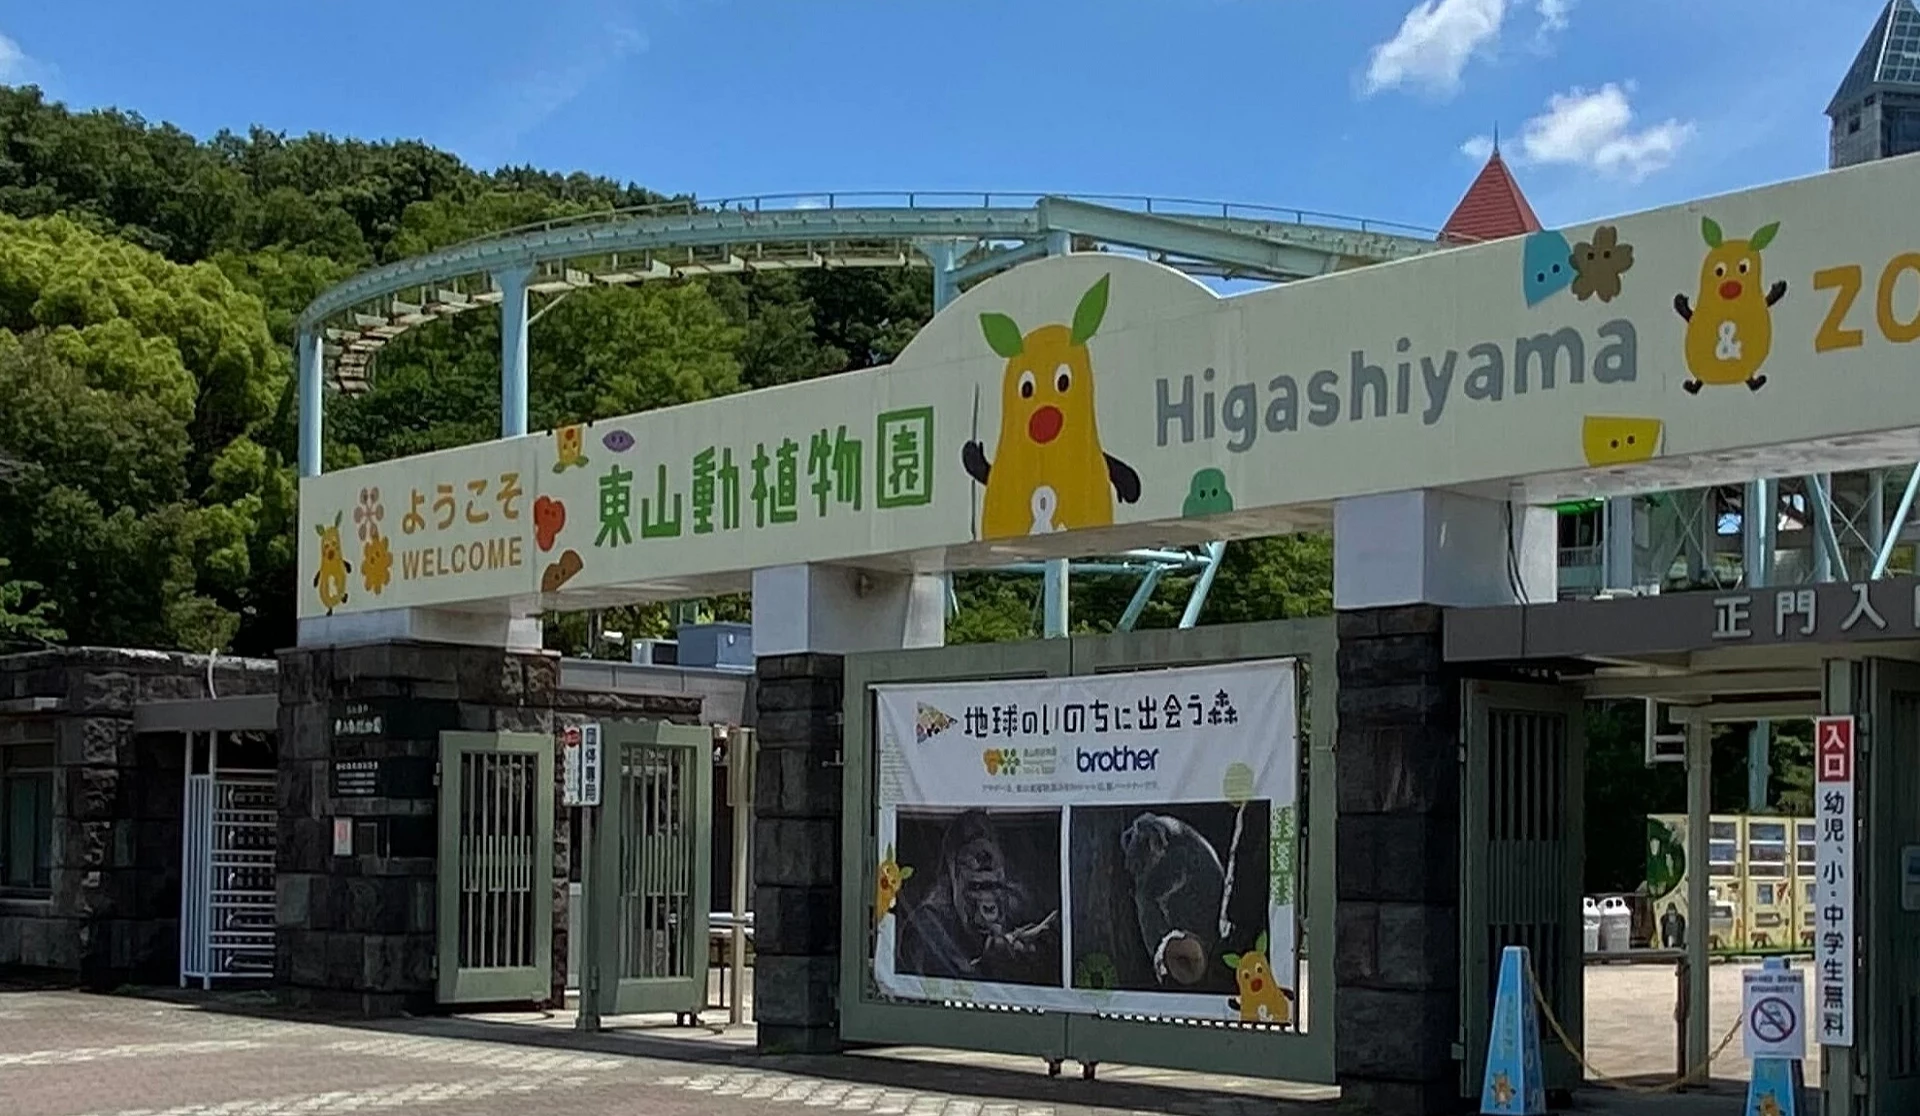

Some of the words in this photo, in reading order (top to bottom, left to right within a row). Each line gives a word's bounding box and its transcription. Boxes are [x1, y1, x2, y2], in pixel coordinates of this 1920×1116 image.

[1155, 317, 1638, 453] Higashiyama
[401, 473, 524, 535] ようこそ
[594, 405, 934, 548] 東山動植物園
[402, 535, 523, 581] WELCOME
[1712, 583, 1920, 639] 正門入
[964, 689, 1238, 738] 地球のいのちに出会う森
[1076, 745, 1160, 773] brother
[1822, 723, 1846, 779] 入口
[1822, 790, 1845, 1037] 幼児、小・中学生無料
